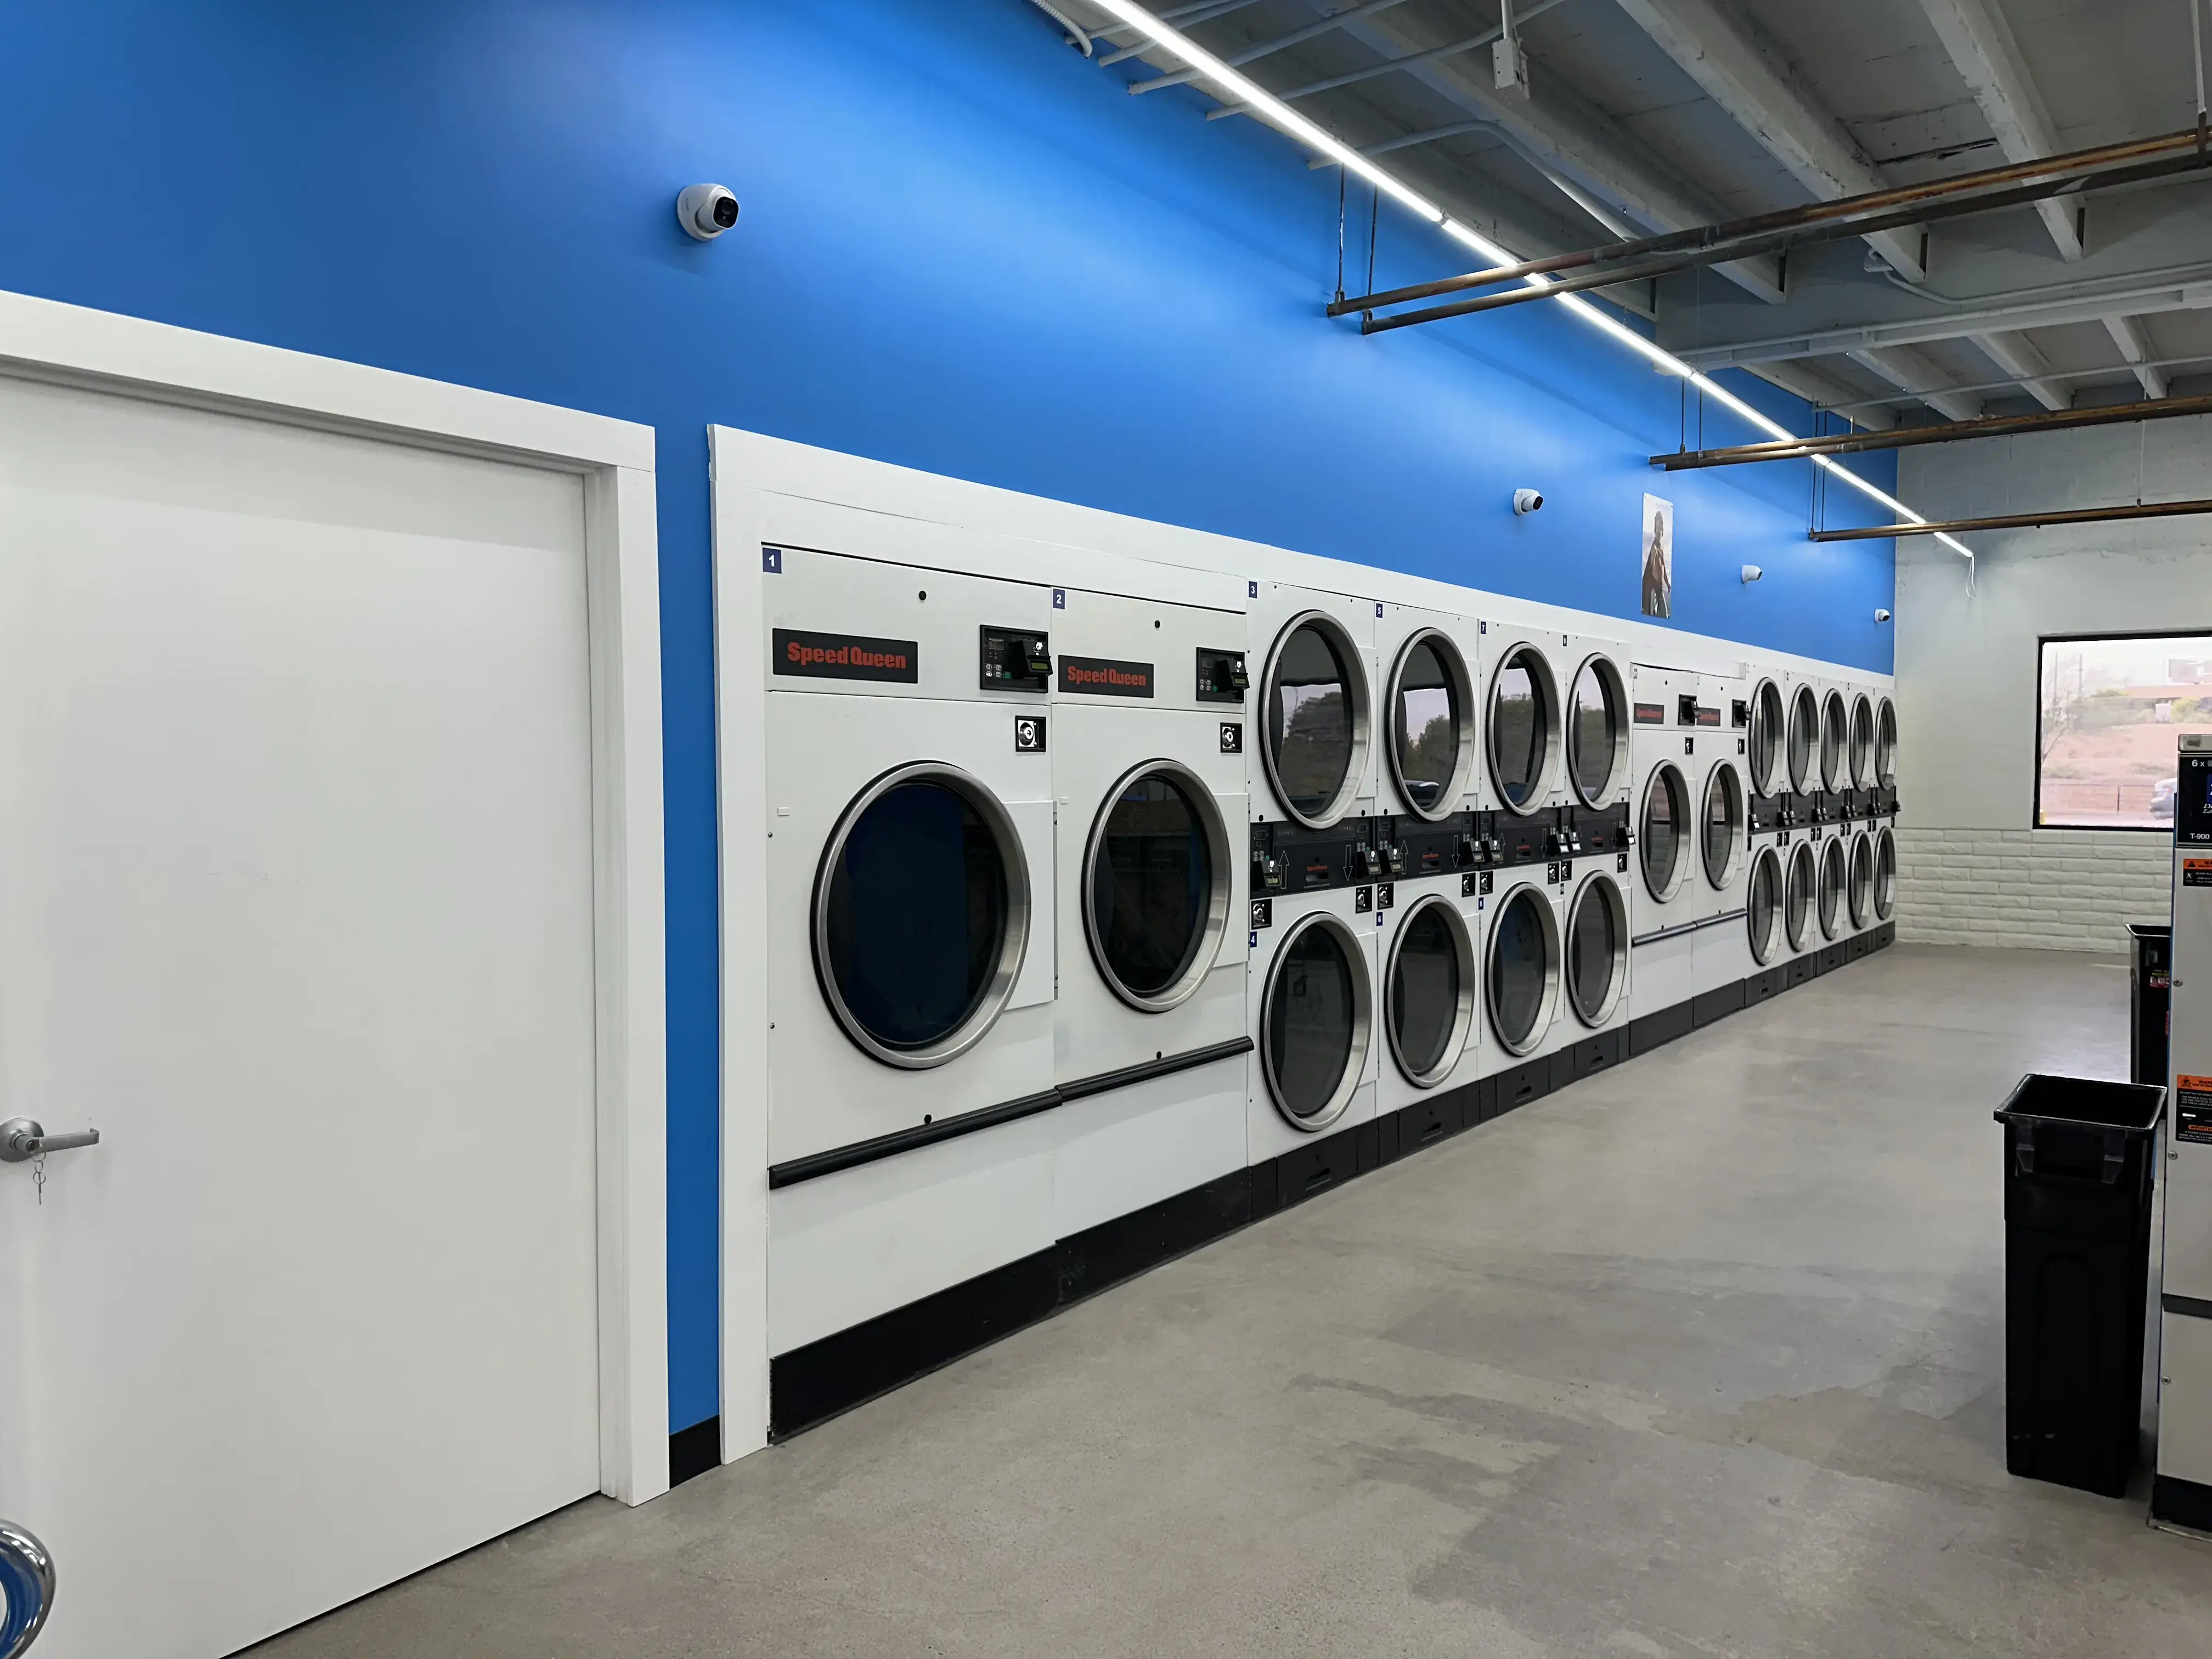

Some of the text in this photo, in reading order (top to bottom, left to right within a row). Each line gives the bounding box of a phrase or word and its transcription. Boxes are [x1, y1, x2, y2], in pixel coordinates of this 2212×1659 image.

[769, 555, 775, 567] 1
[1251, 585, 1255, 594] 3
[1056, 594, 1062, 604] 2
[787, 642, 907, 669] Speed Queen
[1067, 665, 1147, 686] Speed Queen
[1251, 935, 1255, 944] 4
